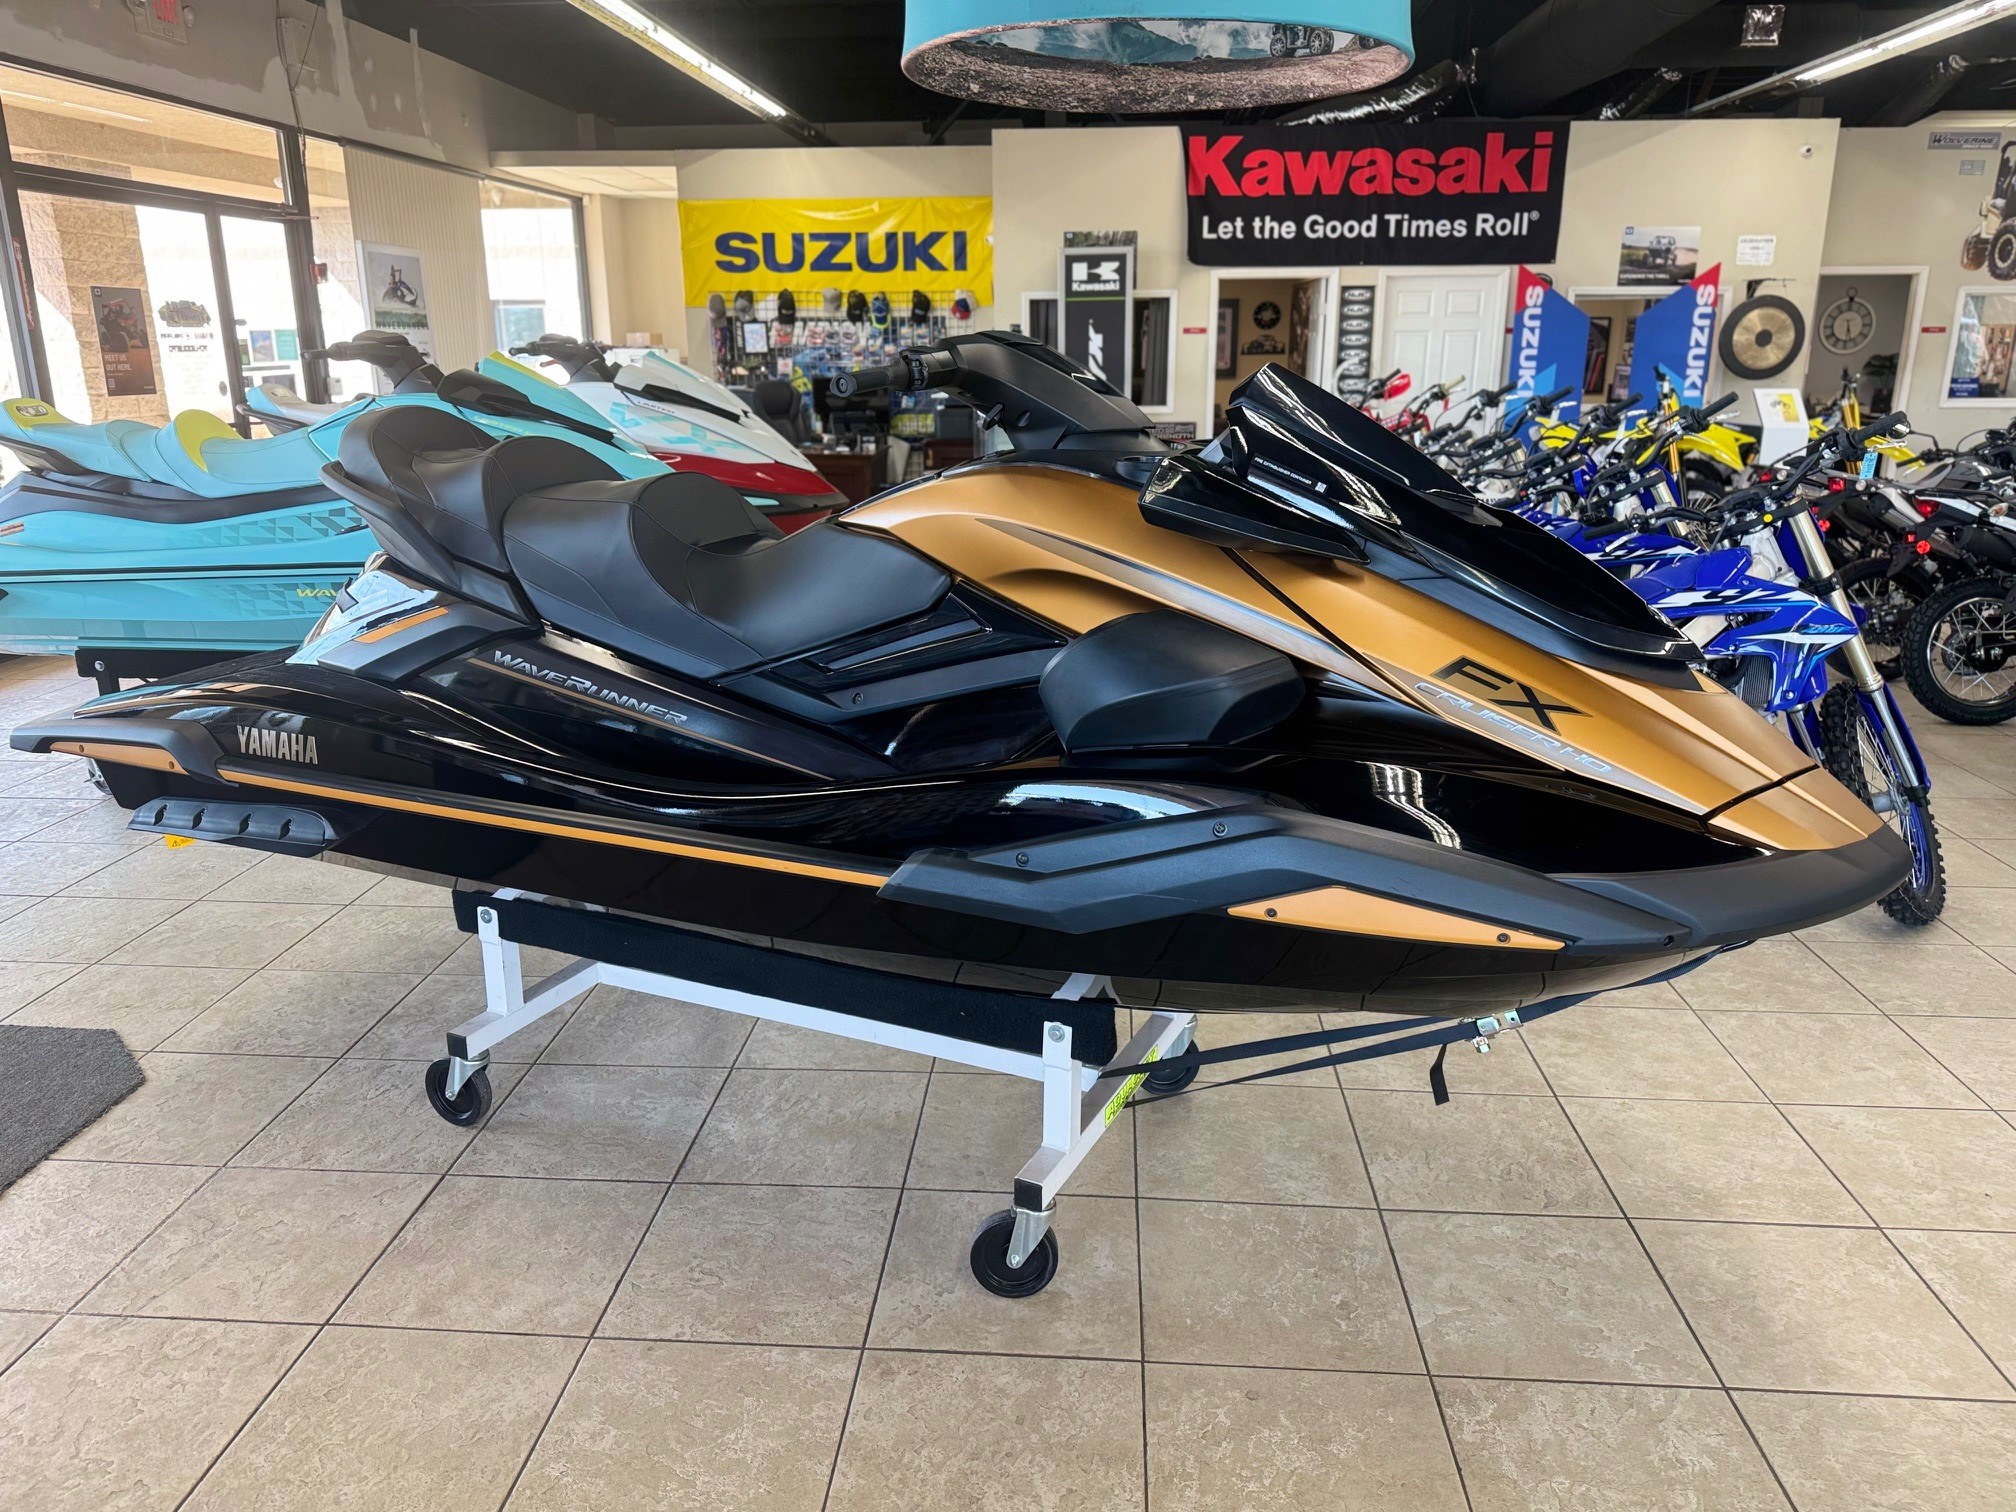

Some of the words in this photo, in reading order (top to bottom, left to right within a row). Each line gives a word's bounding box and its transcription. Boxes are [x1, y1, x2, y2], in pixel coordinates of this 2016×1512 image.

[1932, 134, 1998, 144] WOLVERINE
[1188, 131, 1554, 197] Kawasaki
[1202, 216, 1244, 239] Let
[1252, 215, 1296, 239] the
[1303, 214, 1377, 239] Good
[1384, 213, 1467, 238] Times
[714, 231, 968, 274] SUZUKI
[1071, 281, 1120, 291] Kawasaki
[103, 354, 119, 362] MEET
[1516, 285, 1545, 398] SUZUKI
[1683, 284, 1716, 398] SUZUKI
[106, 363, 116, 371] OUT
[493, 649, 688, 726] WAVERUNNER
[1430, 655, 1593, 737] FX
[236, 724, 319, 766] YAMAHA
[1414, 682, 1562, 749] CRUISER
[1558, 746, 1613, 774] HO
